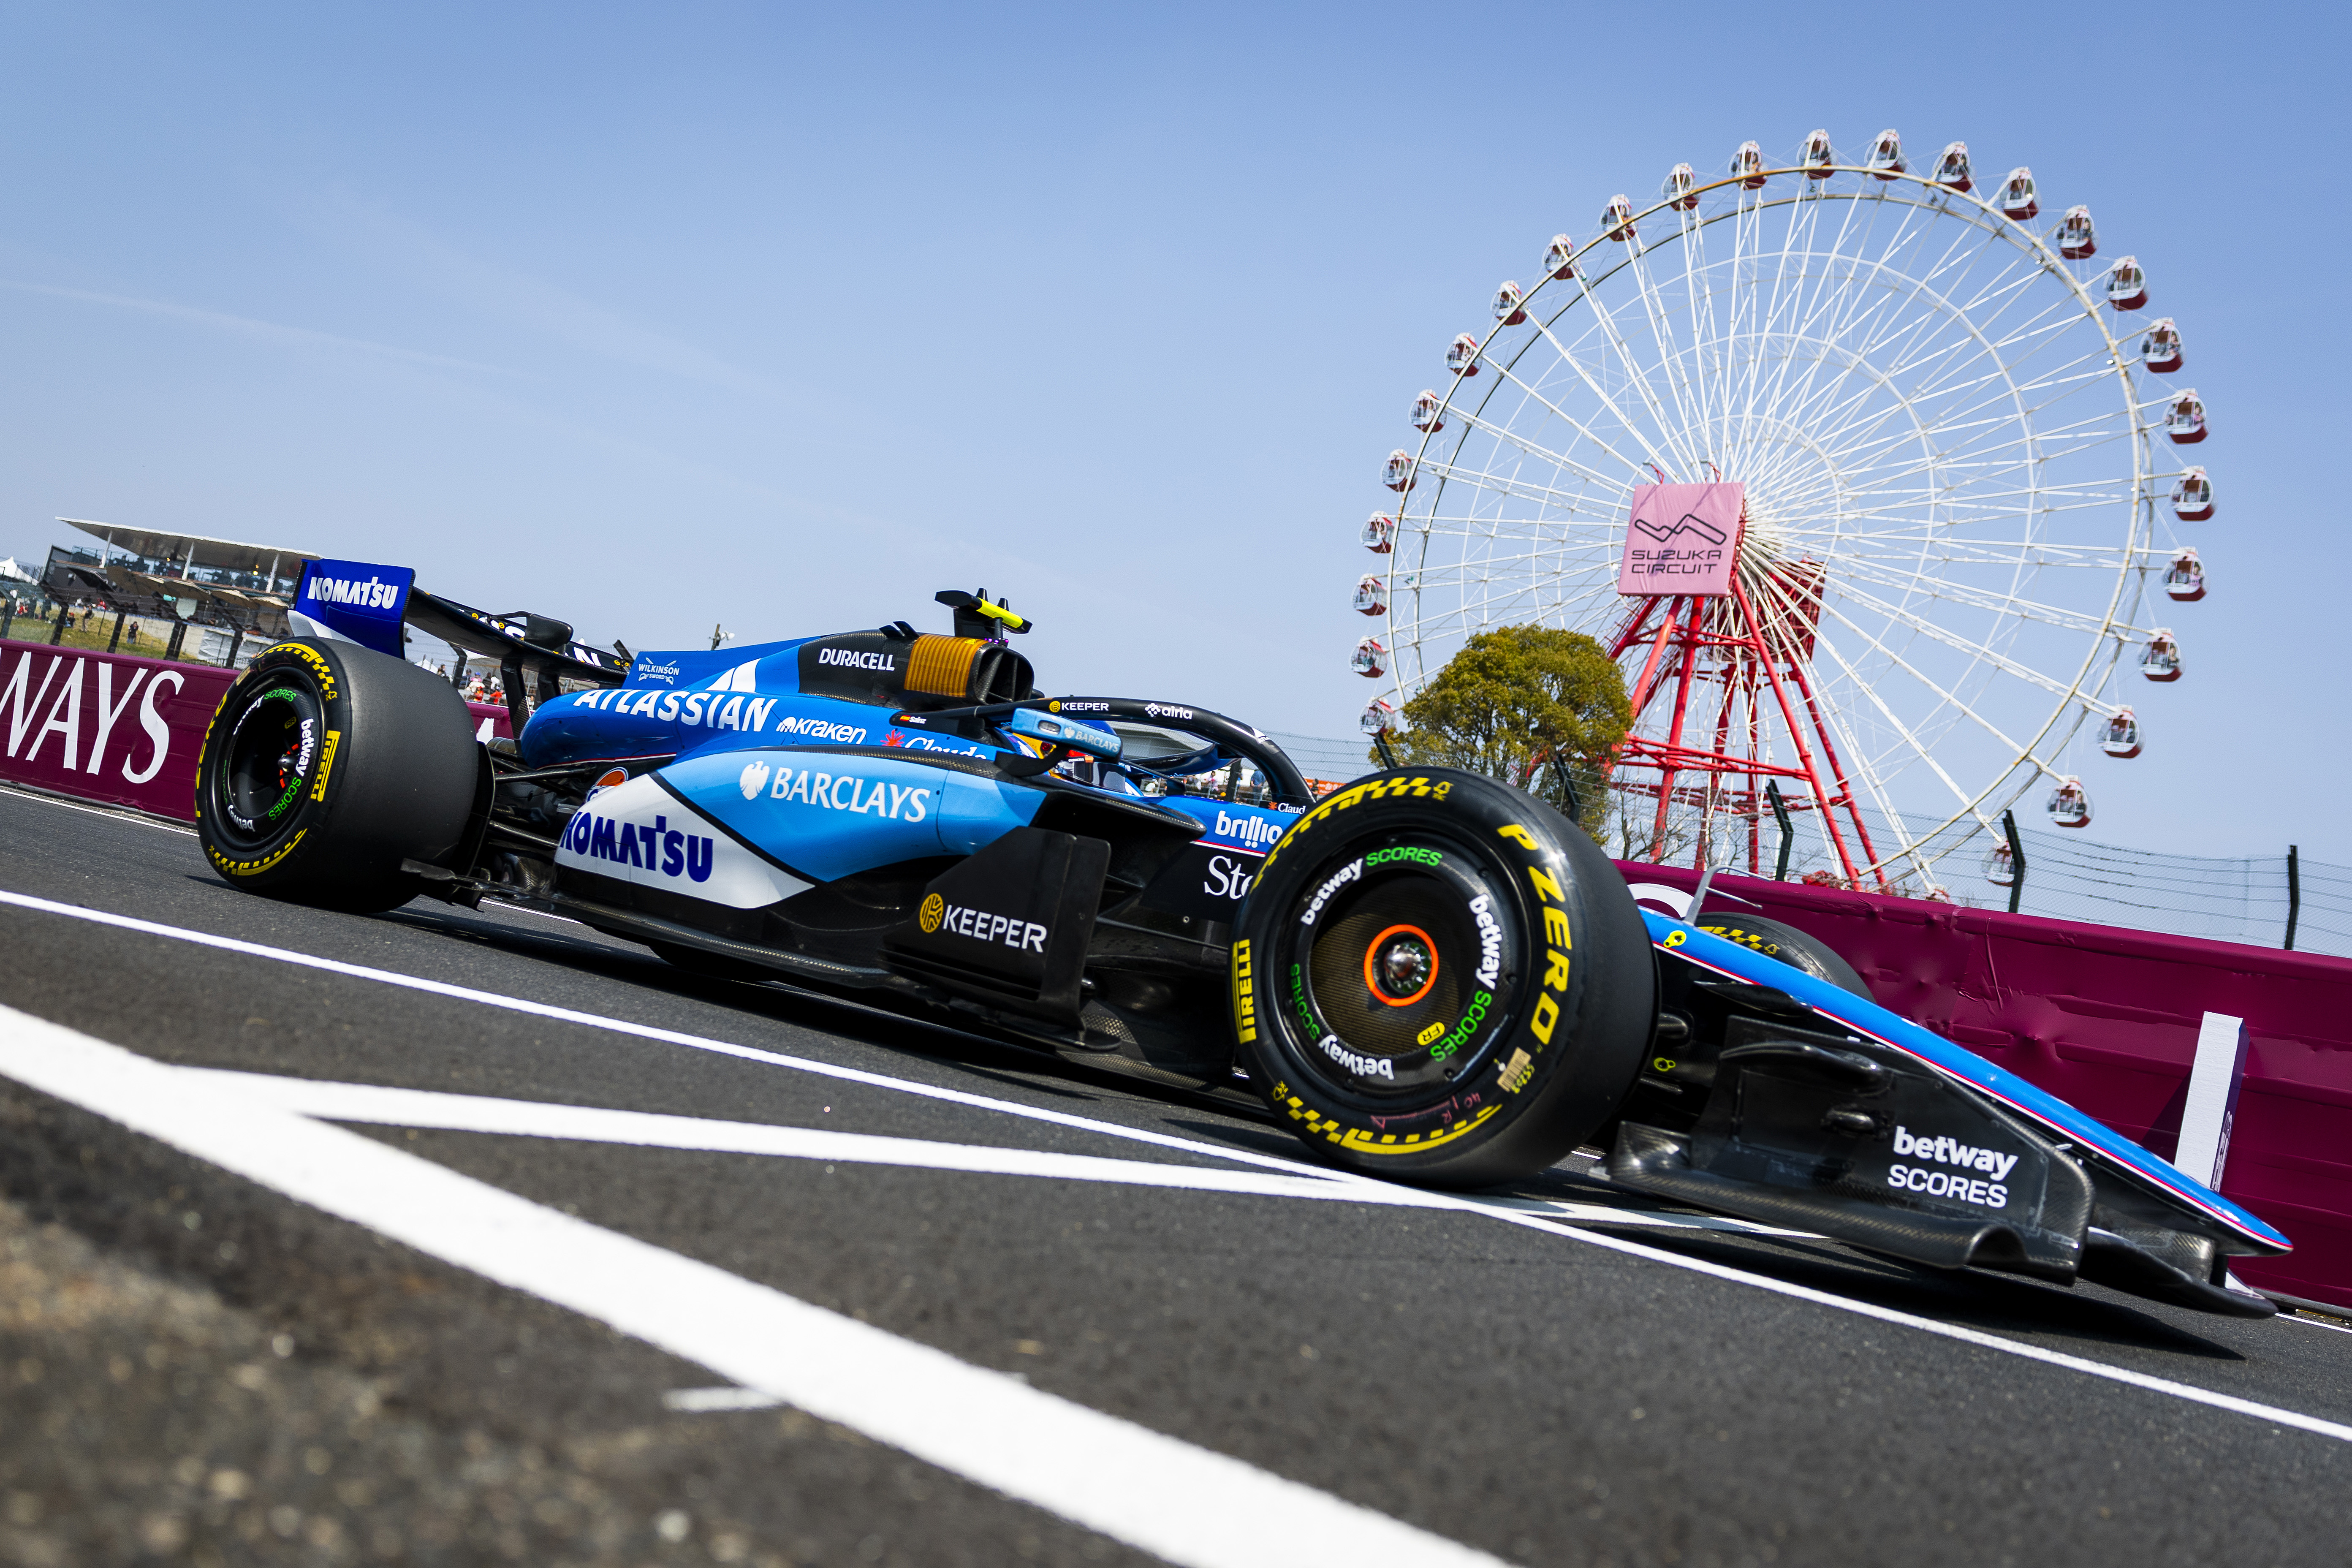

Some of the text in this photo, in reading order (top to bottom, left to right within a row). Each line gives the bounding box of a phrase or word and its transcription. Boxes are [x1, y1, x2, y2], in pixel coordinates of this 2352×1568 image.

[1632, 550, 1722, 560] SUZUKA
[1632, 564, 1717, 573] CIRCUIT
[307, 576, 399, 609] KOMATSU
[638, 663, 680, 675] WILKINSON
[818, 648, 895, 671] DURACELL
[264, 689, 297, 702] SCORES
[573, 689, 778, 732] ATLASSIAN
[1062, 702, 1109, 711] KEEPER
[1161, 705, 1193, 720] airia
[796, 719, 867, 745] kraken
[909, 716, 927, 724] Sainz
[1075, 731, 1119, 753] BARCLAYS
[268, 718, 314, 821] betway SCORES
[310, 730, 341, 802] PIRELLI
[770, 767, 930, 825] BARCLAYS
[1278, 803, 1306, 814] Claud
[560, 811, 713, 883] KOMATSU
[1215, 810, 1283, 848] brillio
[1300, 846, 1442, 926] betway SCORES
[942, 905, 1048, 953] KEEPER
[1496, 823, 1573, 1045] P ZERO
[1232, 939, 1257, 1044] PIRELLI
[1430, 894, 1503, 1062] betway SCORES
[1290, 963, 1395, 1080] betway SCORES
[1422, 1026, 1440, 1042] FR
[1893, 1125, 2018, 1181] betway
[1887, 1164, 2008, 1209] SCORES
